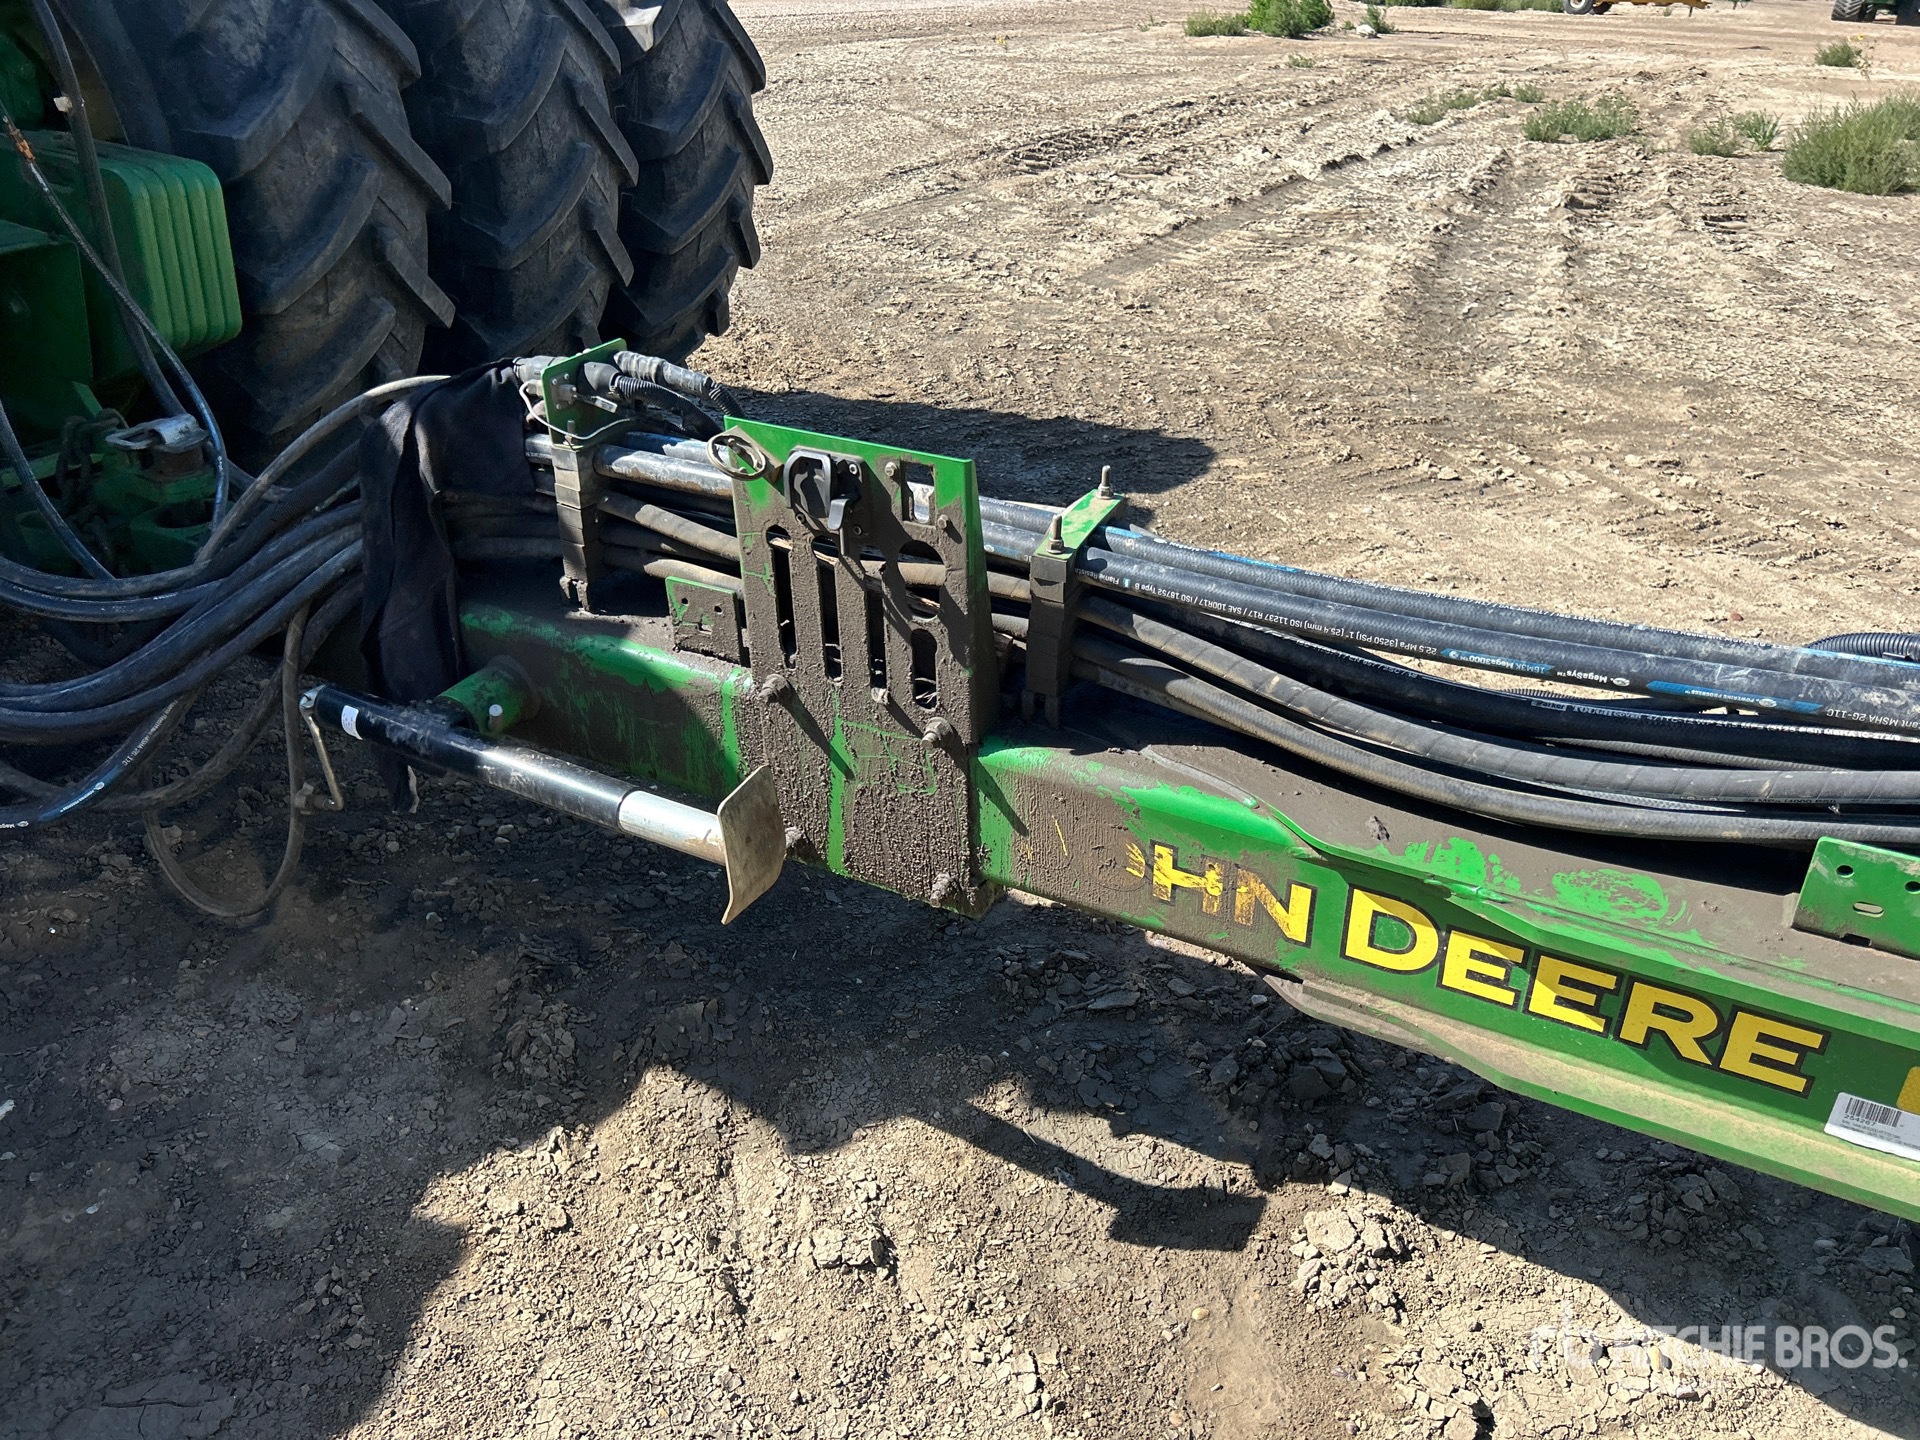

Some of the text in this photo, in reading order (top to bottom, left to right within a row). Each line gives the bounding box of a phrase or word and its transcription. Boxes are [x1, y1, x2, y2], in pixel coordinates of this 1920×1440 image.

[1097, 572, 1120, 584] Flame
[1133, 581, 1140, 589] B
[1139, 582, 1157, 594] Type
[1156, 587, 1179, 600] 18752
[1178, 592, 1193, 603] ISO
[1198, 597, 1226, 611] 100R17
[1226, 604, 1242, 615] SAE
[1247, 608, 1264, 620] R17
[1263, 613, 1288, 625] 11237
[1288, 618, 1304, 629] ISO
[1398, 640, 1418, 651] MPa
[1417, 644, 1437, 655] 22.5
[1825, 707, 1866, 721] 2G-11C
[1867, 714, 1899, 726] MSHA
[1342, 884, 1833, 1098] DEERE
[1843, 1113, 1877, 1126] 254267
